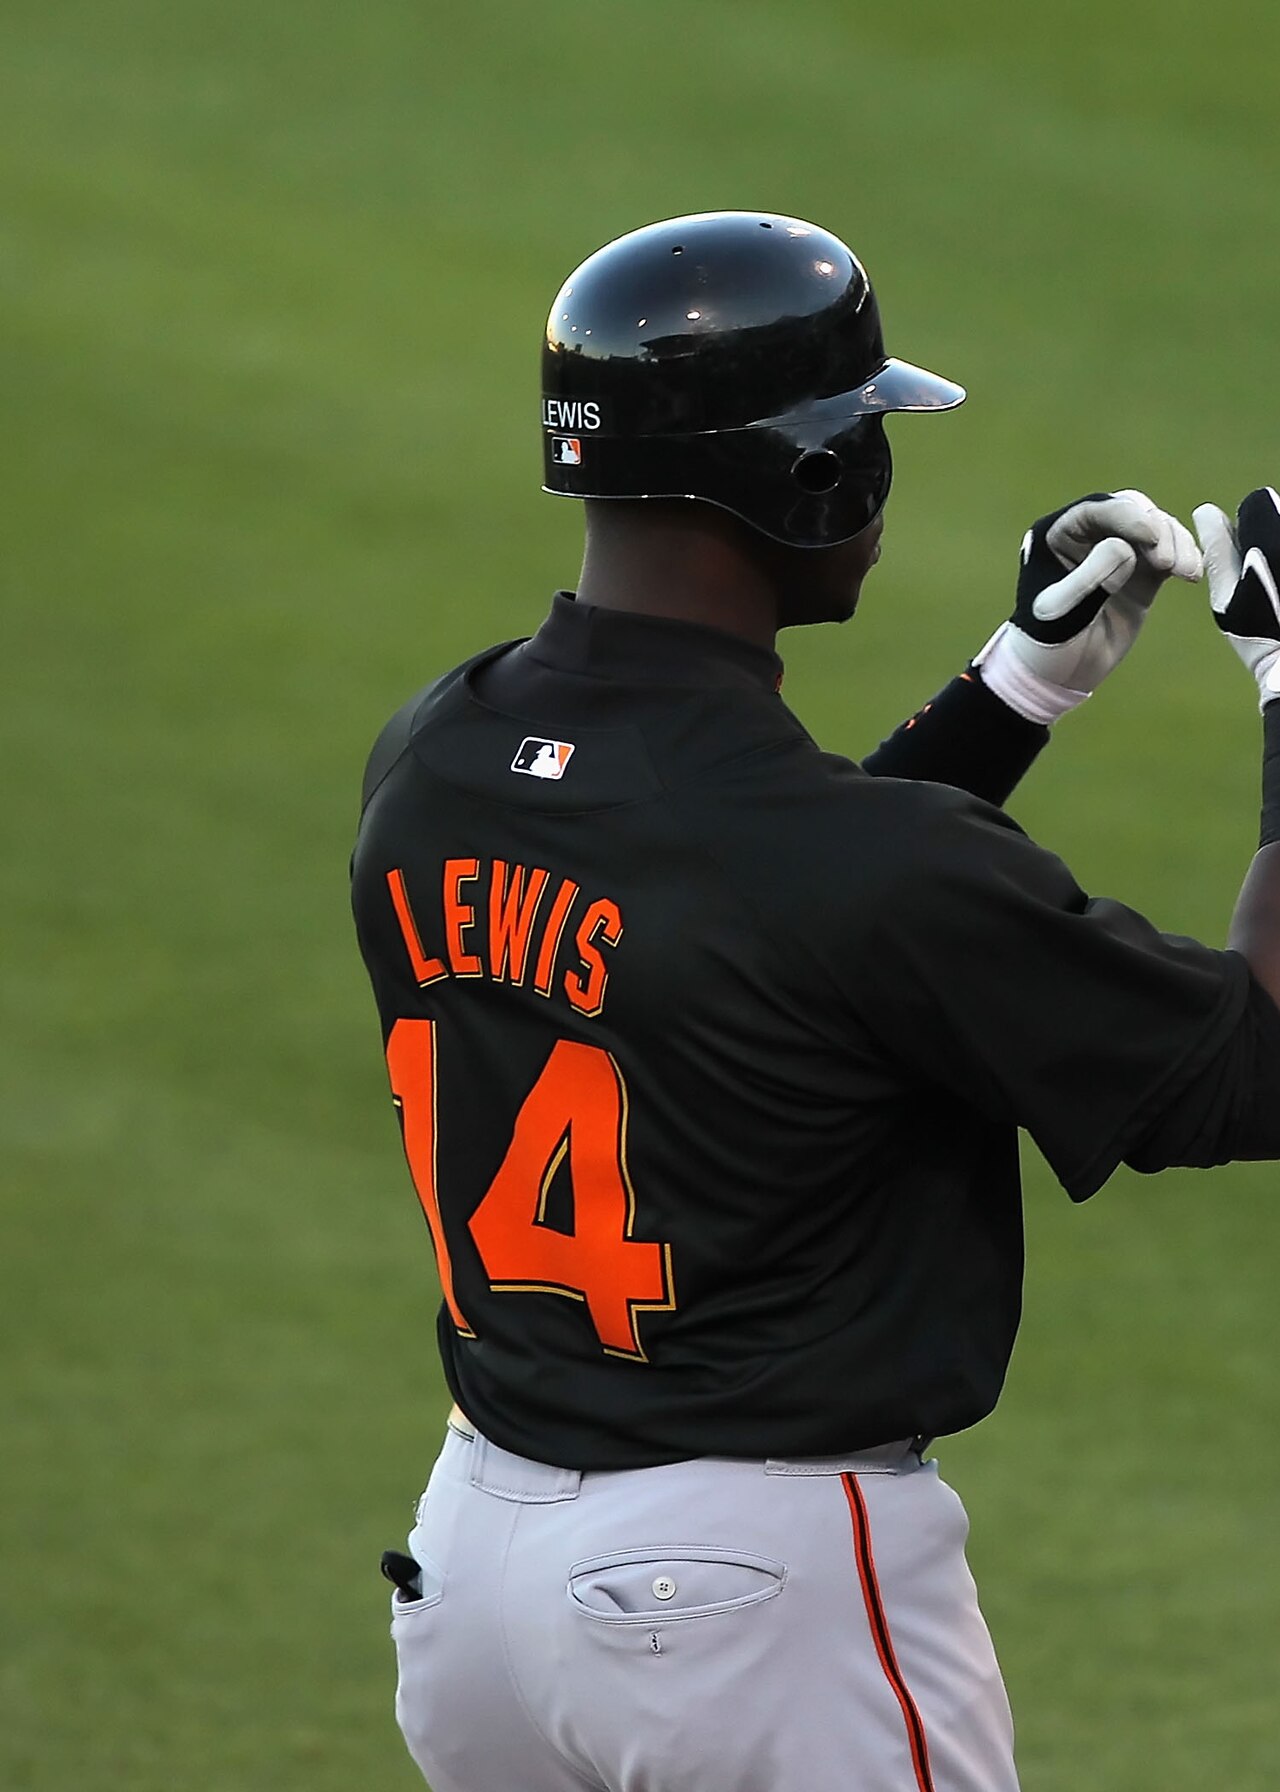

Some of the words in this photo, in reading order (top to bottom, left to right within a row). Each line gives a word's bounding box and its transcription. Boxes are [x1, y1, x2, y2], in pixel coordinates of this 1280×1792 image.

[542, 399, 601, 430] LEWIS
[386, 858, 623, 1018] LEWIS
[386, 1017, 676, 1363] 14
